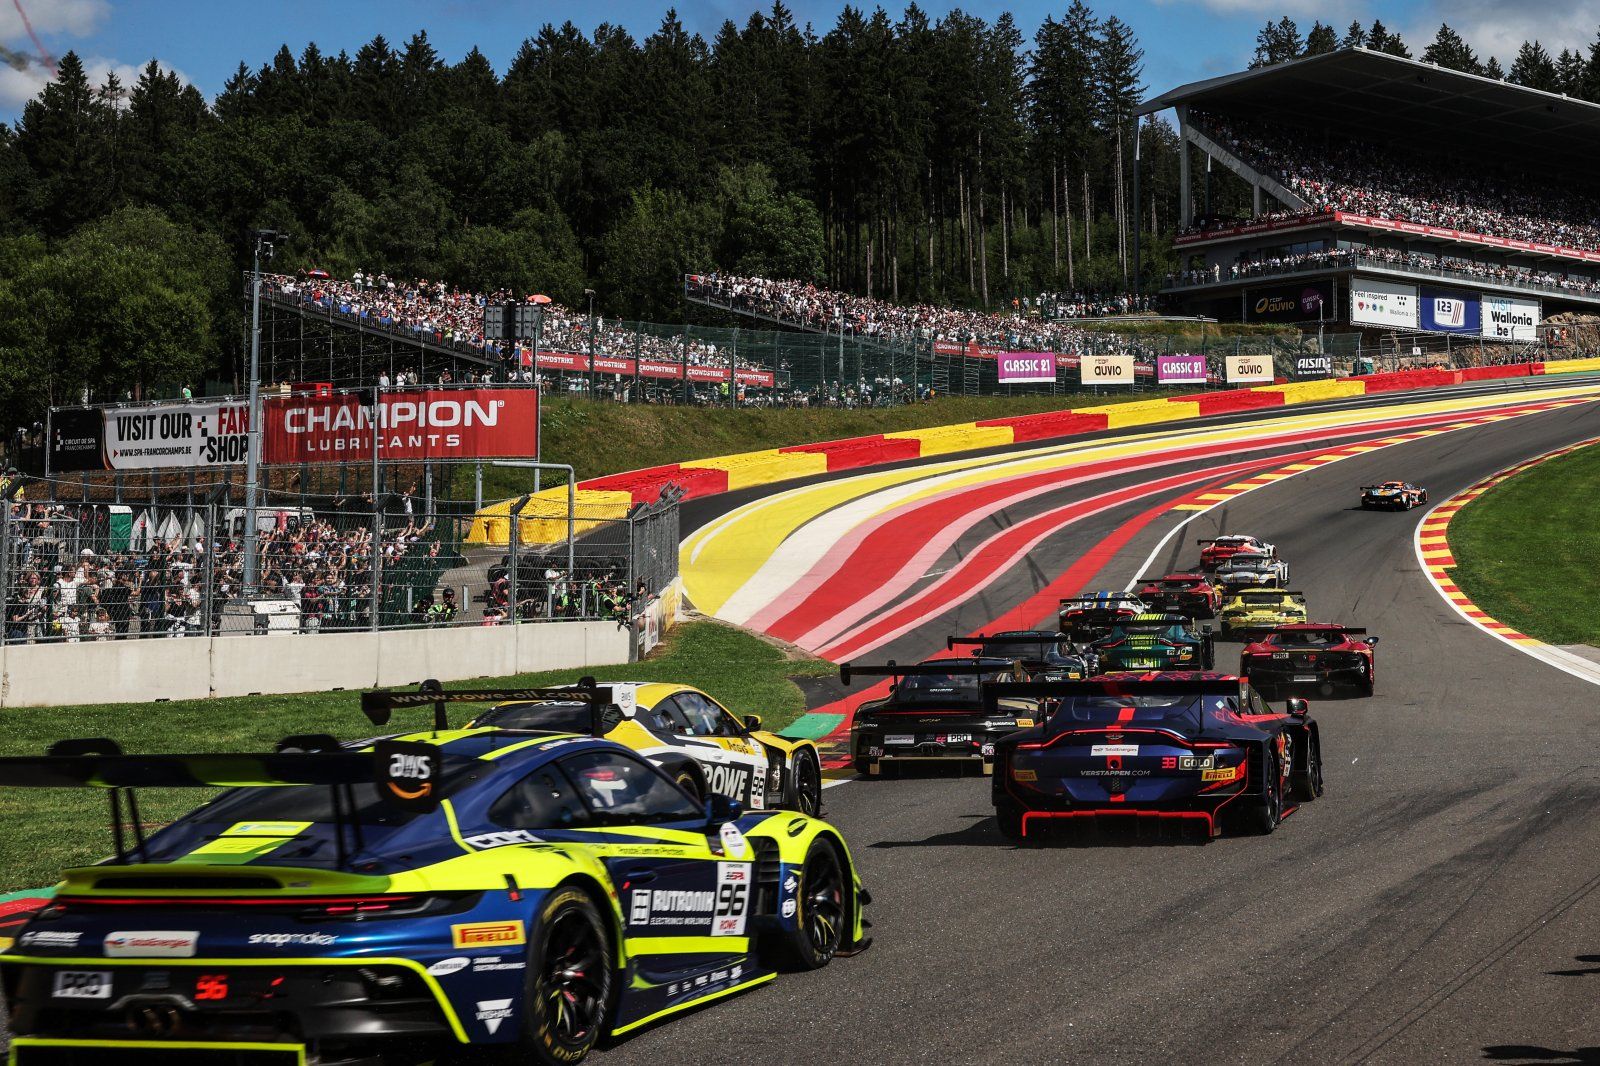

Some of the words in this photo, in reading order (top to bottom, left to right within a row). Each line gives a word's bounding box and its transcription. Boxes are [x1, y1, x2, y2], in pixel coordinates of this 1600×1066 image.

[1366, 290, 1388, 301] inspired
[1437, 300, 1452, 313] 123
[1490, 299, 1514, 312] VISIT
[1491, 311, 1533, 326] Wallonia
[1003, 359, 1039, 372] CLASSIC
[1041, 359, 1051, 371] 21
[1162, 362, 1193, 374] CLASSIC
[1194, 361, 1202, 373] 21
[1238, 365, 1263, 375] auvio
[1297, 357, 1326, 369] AISIN
[1094, 365, 1122, 376] auvio
[116, 414, 157, 441] VISIT
[159, 412, 192, 439] OUR
[218, 407, 250, 435] FAN
[206, 435, 249, 463] SHOP
[390, 690, 593, 705] www.rowe-oil.com
[951, 733, 968, 742] PRO
[389, 753, 431, 779] aws
[1161, 757, 1176, 769] 33
[1183, 758, 1210, 768] GOLD
[751, 776, 764, 797] 98
[651, 889, 715, 912] RUTRONIK
[717, 883, 747, 916] 96
[459, 925, 518, 944] PIRELLI
